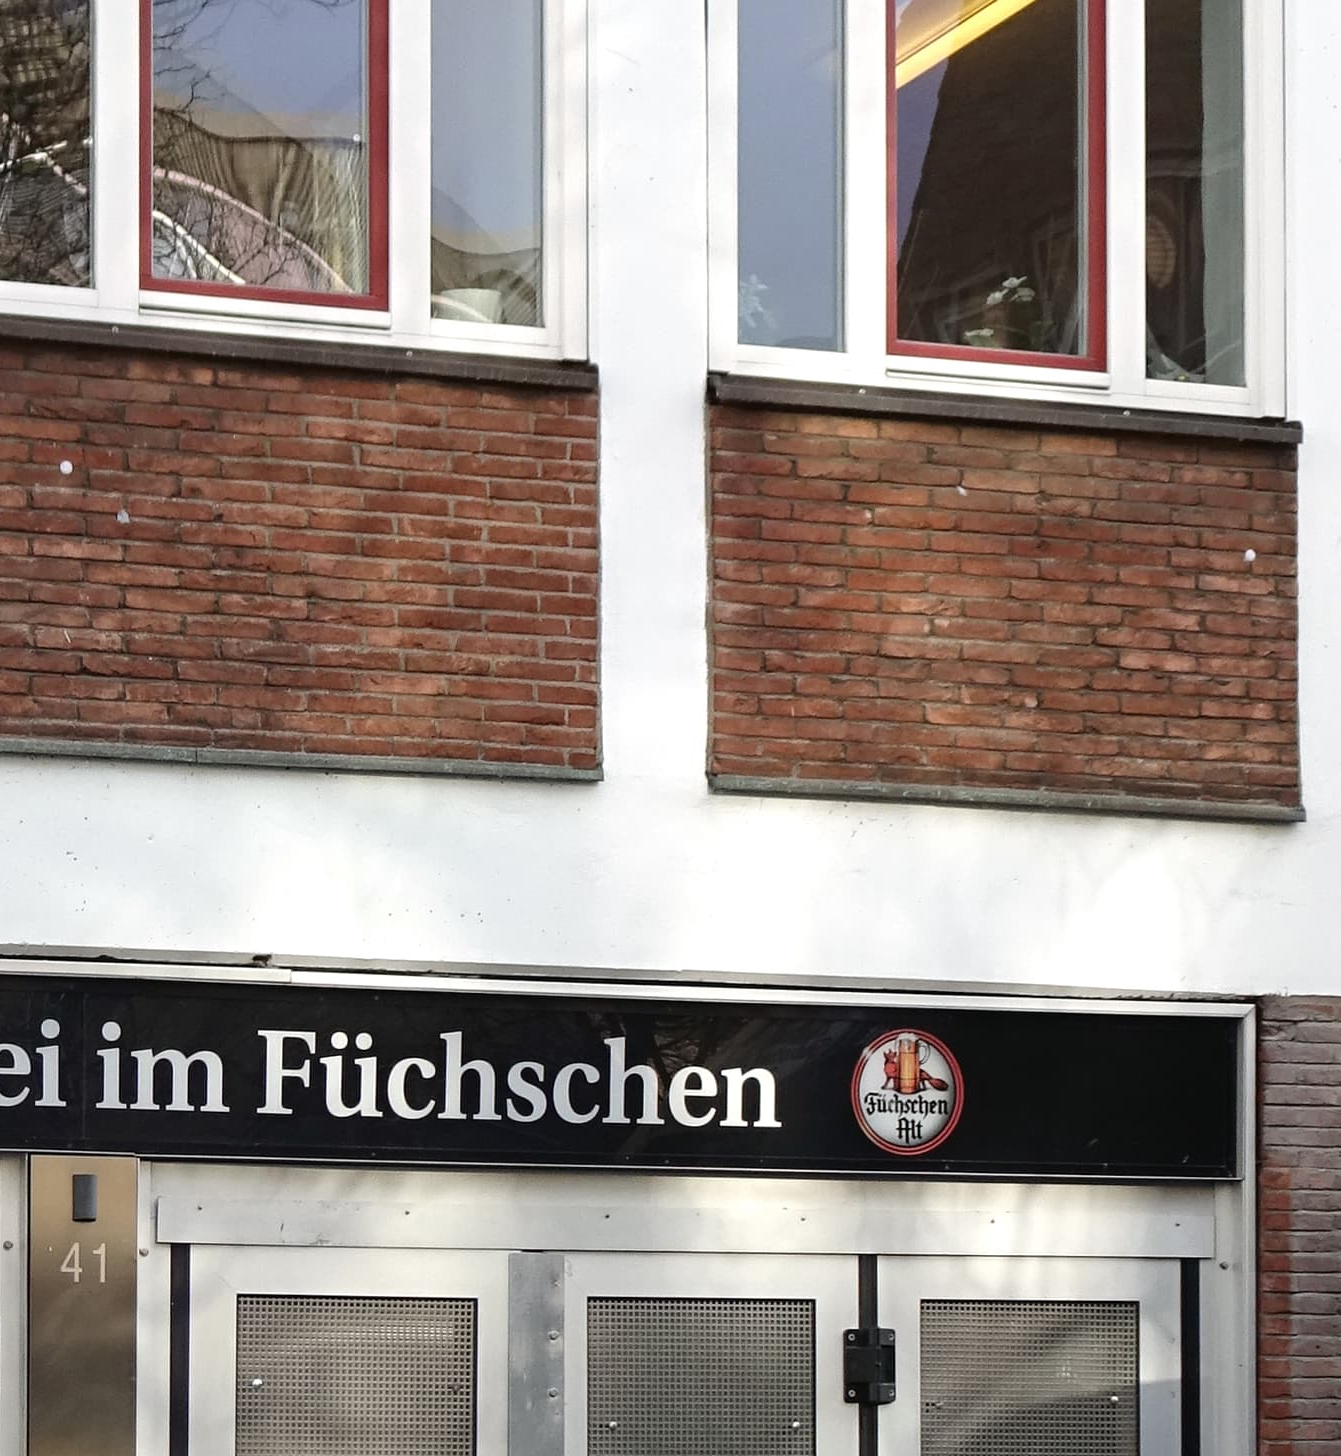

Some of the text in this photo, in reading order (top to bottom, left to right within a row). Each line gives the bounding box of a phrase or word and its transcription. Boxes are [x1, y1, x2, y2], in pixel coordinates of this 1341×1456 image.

[95, 1021, 230, 1114] im
[256, 1029, 783, 1129] Füchschen
[864, 1092, 949, 1121] Füchschen
[896, 1117, 923, 1144] Alt
[60, 1241, 106, 1283] 41
